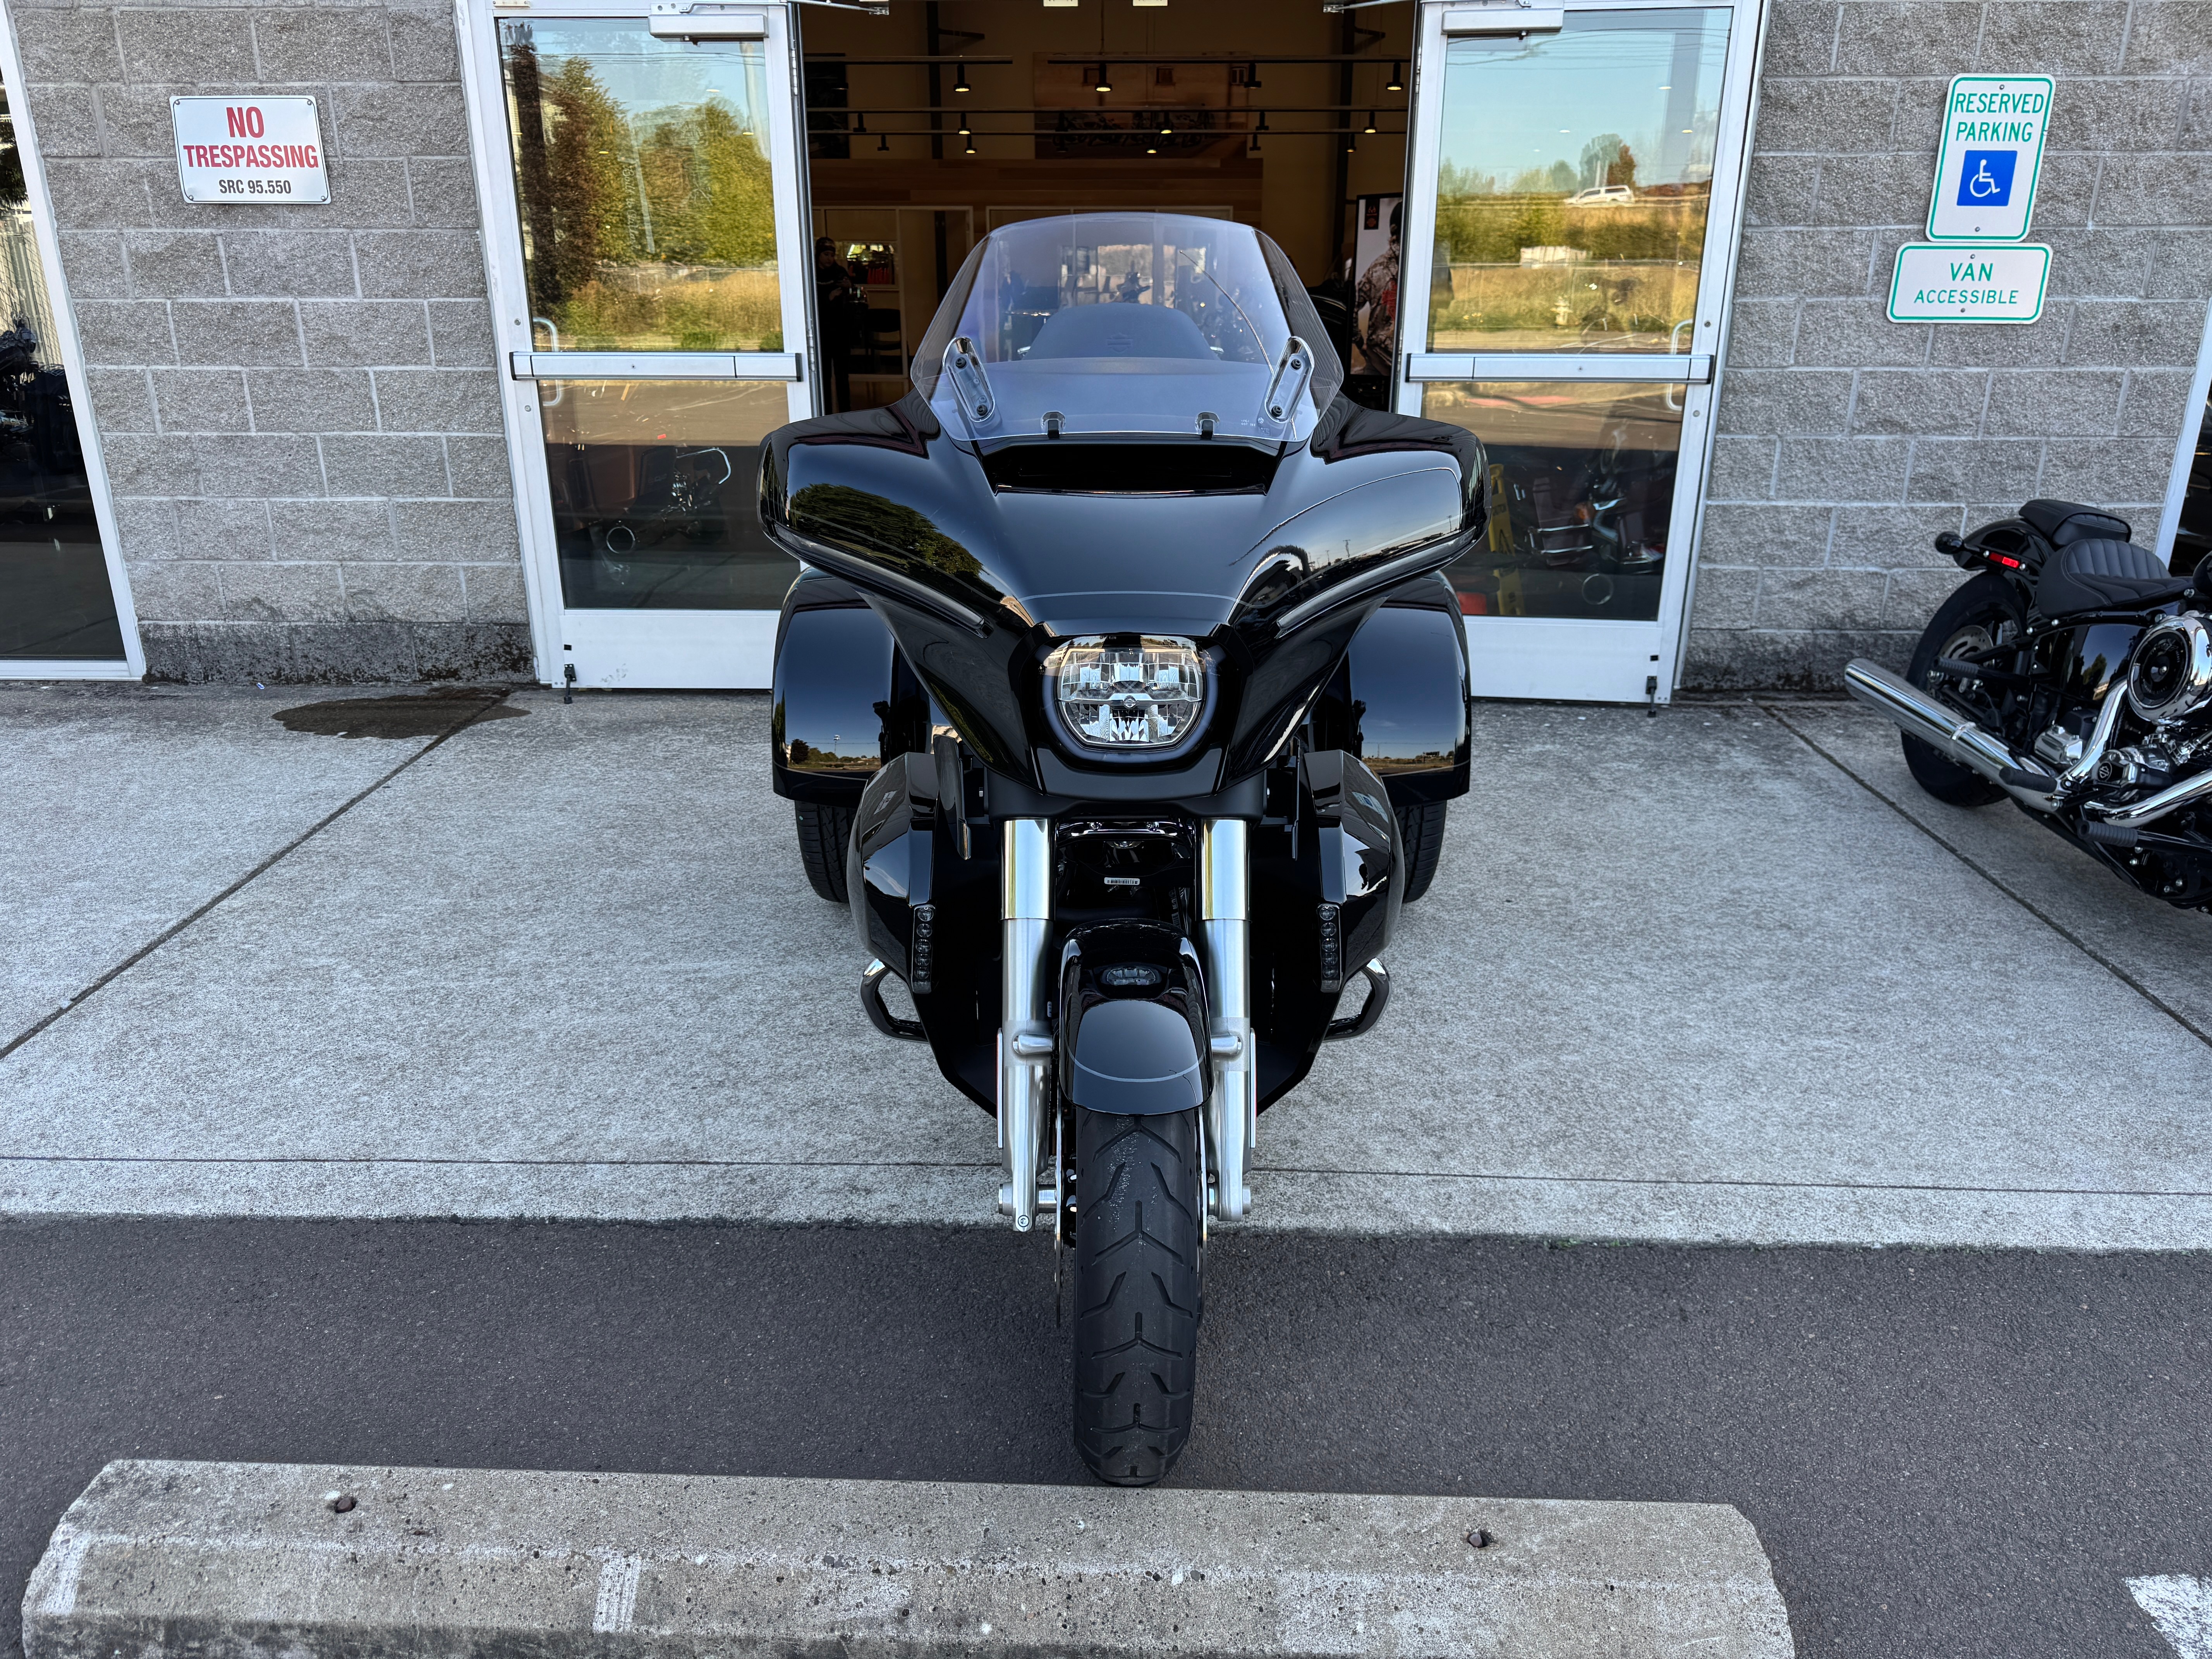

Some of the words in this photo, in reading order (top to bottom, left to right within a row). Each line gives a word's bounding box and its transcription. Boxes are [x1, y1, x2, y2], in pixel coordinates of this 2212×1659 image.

[1954, 93, 2044, 113] RESERVED
[226, 106, 264, 138] NO
[1956, 122, 2033, 142] PARKING
[183, 145, 319, 168] TRESPASSING
[219, 180, 244, 194] SRC
[248, 180, 291, 194] 95.550
[1950, 263, 1993, 282] VAN
[1914, 290, 2019, 304] ACCESSIBLE
